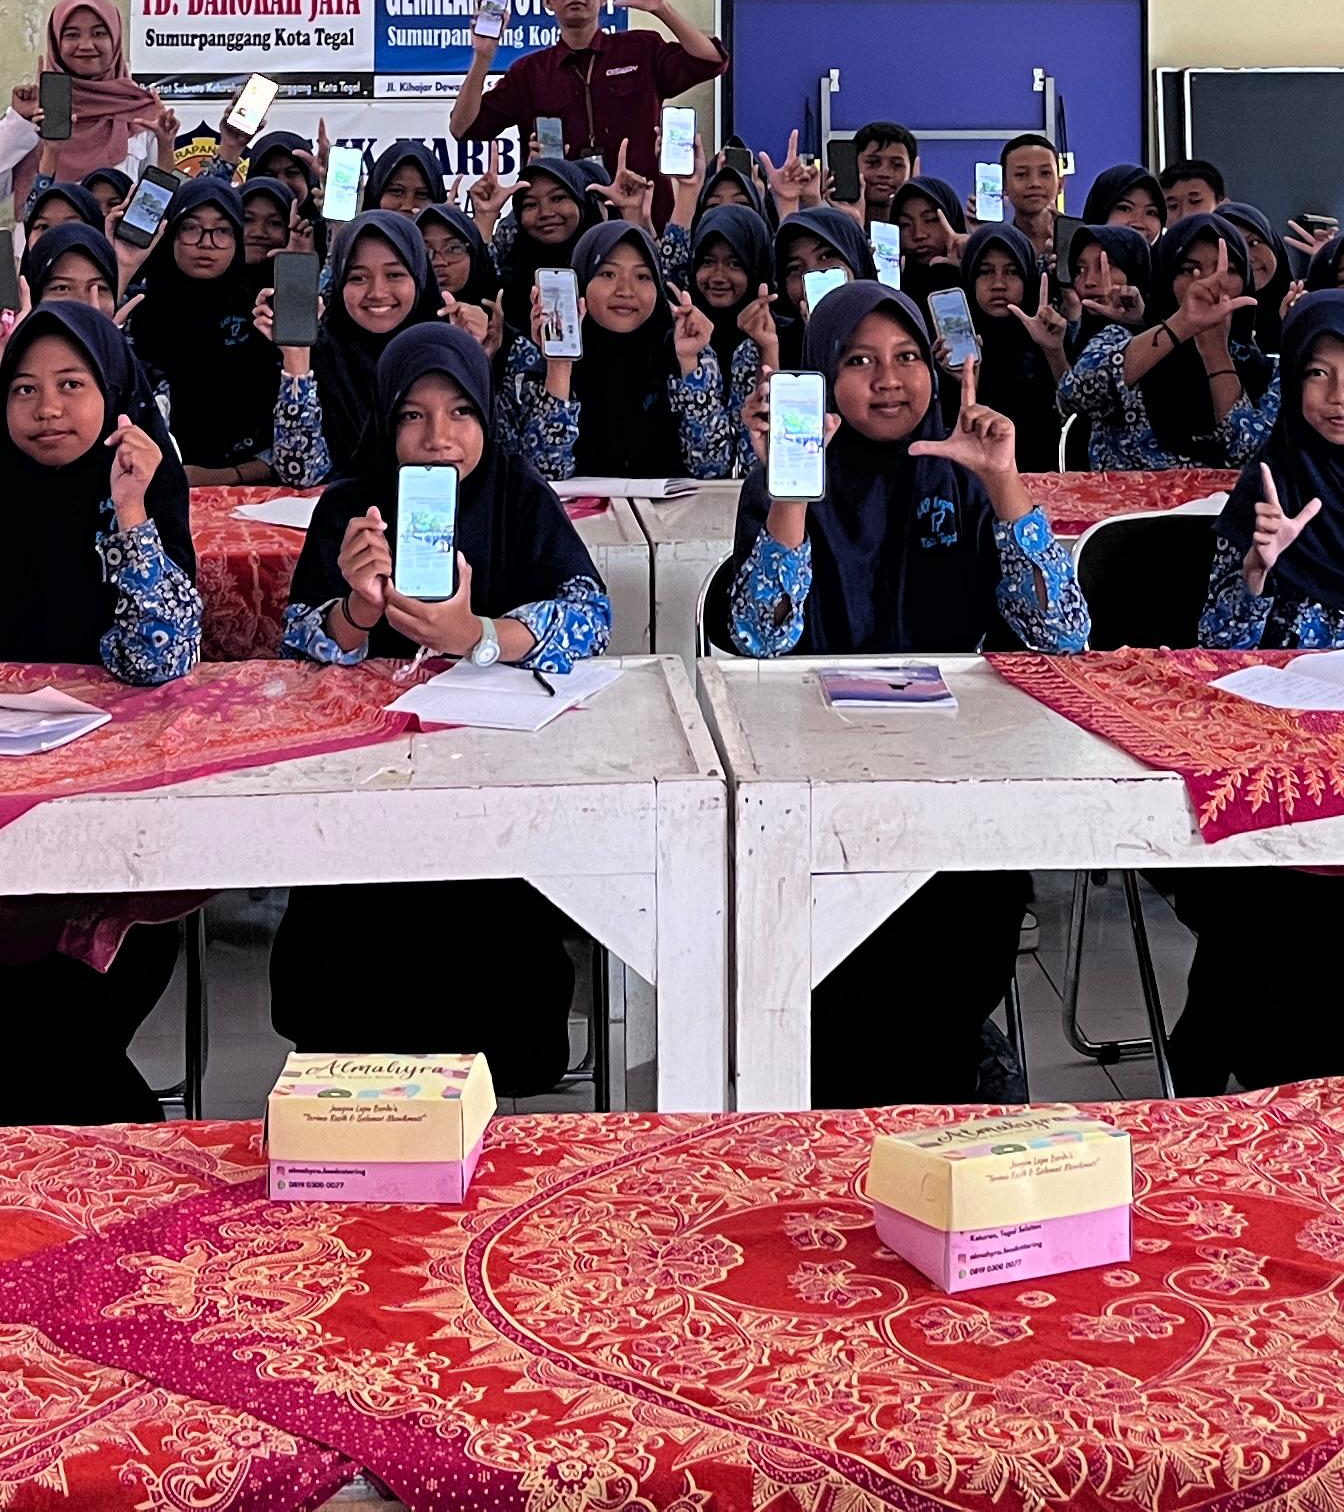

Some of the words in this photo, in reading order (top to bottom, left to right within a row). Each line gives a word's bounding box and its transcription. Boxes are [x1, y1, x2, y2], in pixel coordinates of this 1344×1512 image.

[145, 28, 271, 51] Sumurpanggang
[274, 28, 311, 47] Kota
[314, 28, 354, 51] Tegal
[387, 26, 524, 48] Sumurpanng
[319, 81, 338, 93] Kota
[339, 81, 360, 95] Tegal
[399, 82, 432, 94] Kihajar
[306, 1059, 444, 1080] Almahyra
